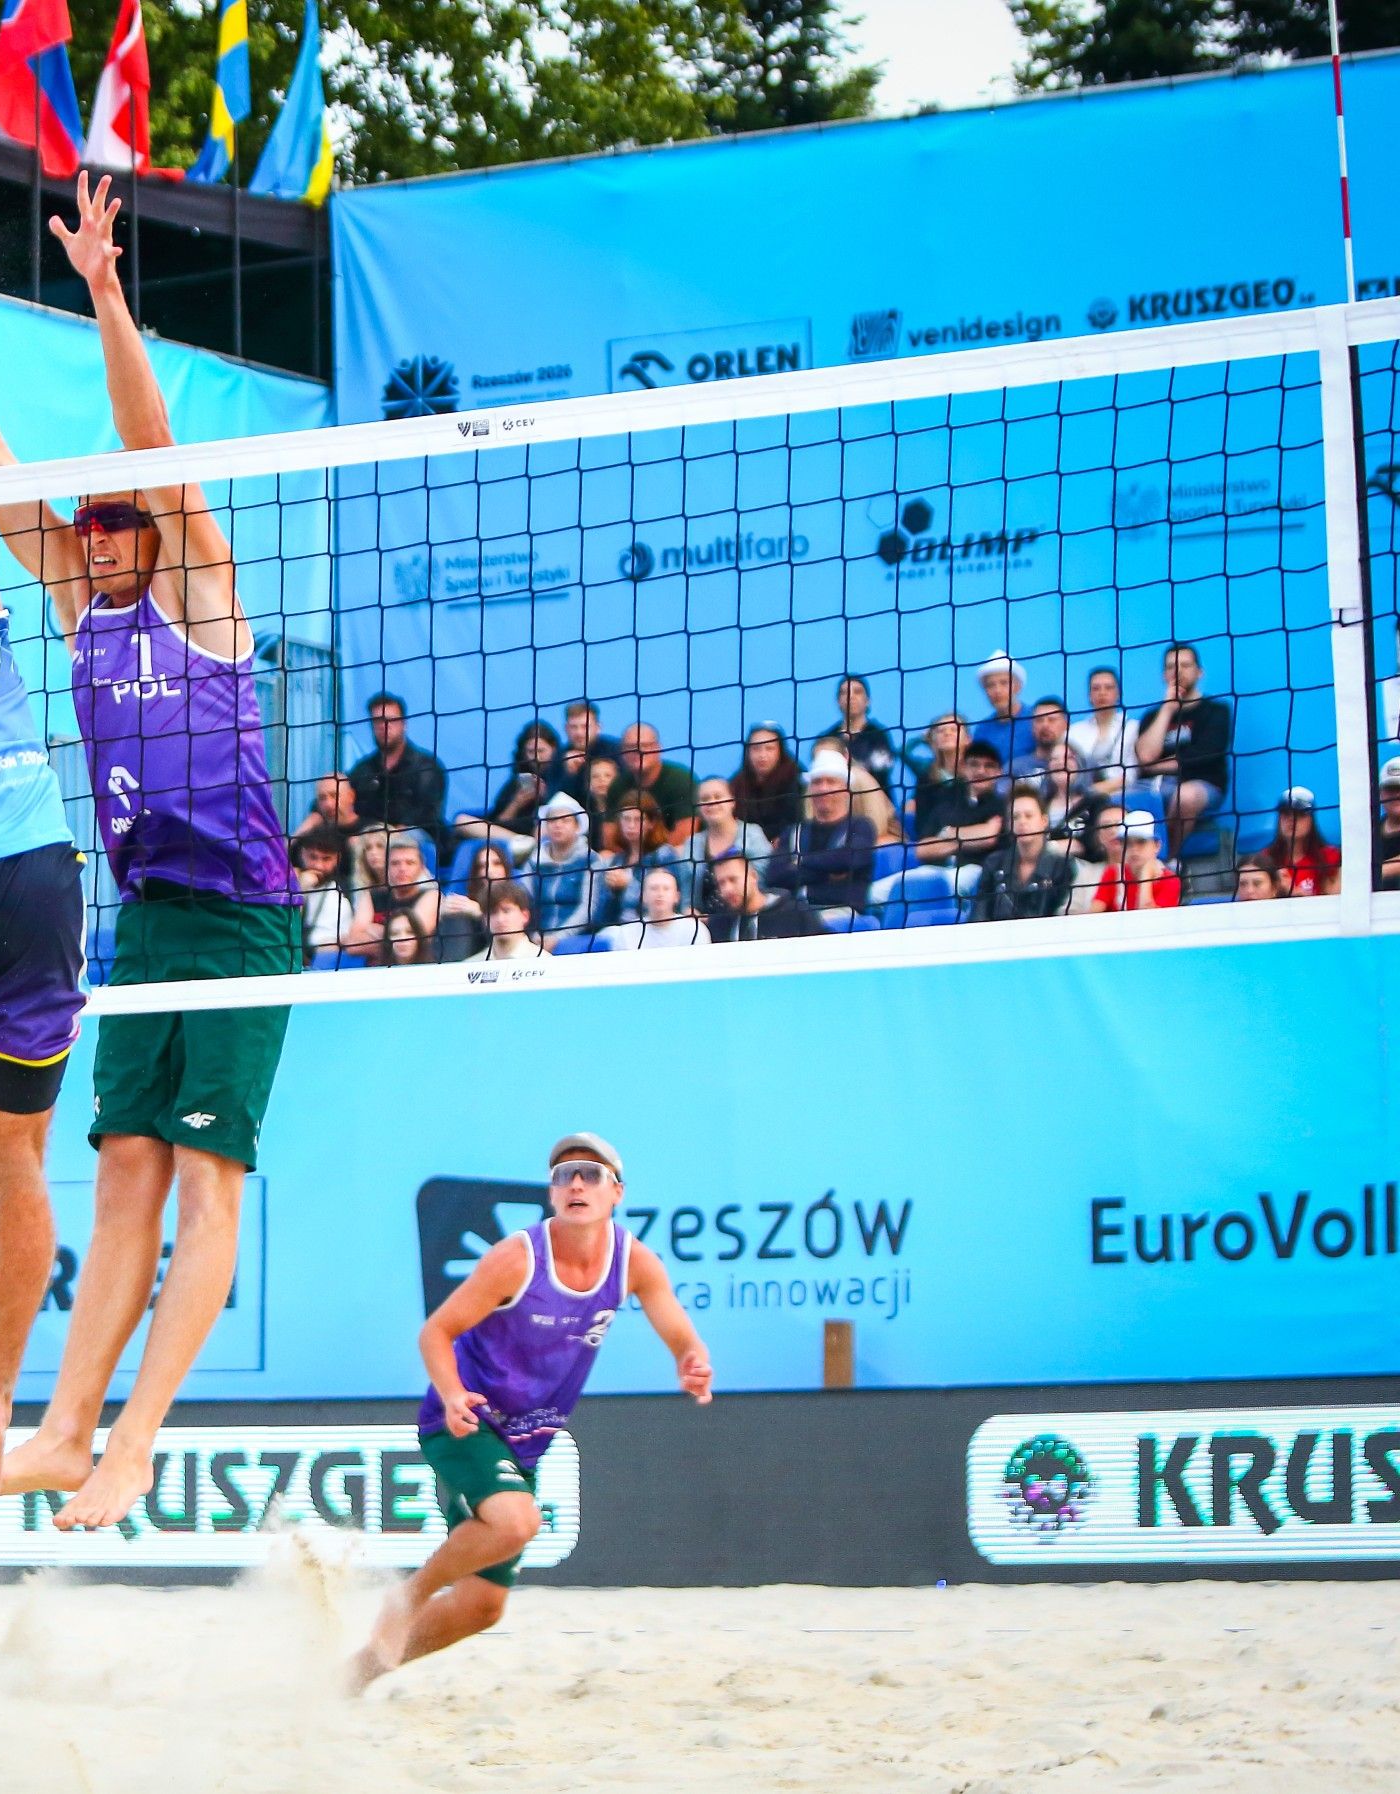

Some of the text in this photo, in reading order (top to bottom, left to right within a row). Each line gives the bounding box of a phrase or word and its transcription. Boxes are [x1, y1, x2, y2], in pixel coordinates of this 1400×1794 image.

[1128, 278, 1296, 322] KRUSZGEO
[908, 310, 1061, 347] venidesign
[686, 342, 800, 382] ORLEN
[661, 530, 810, 569] multifarb
[131, 633, 152, 676] 1
[112, 672, 181, 704] POL
[614, 1188, 913, 1262] zeszów
[1090, 1180, 1399, 1265] EuroVoll
[728, 1268, 911, 1321] innowacji
